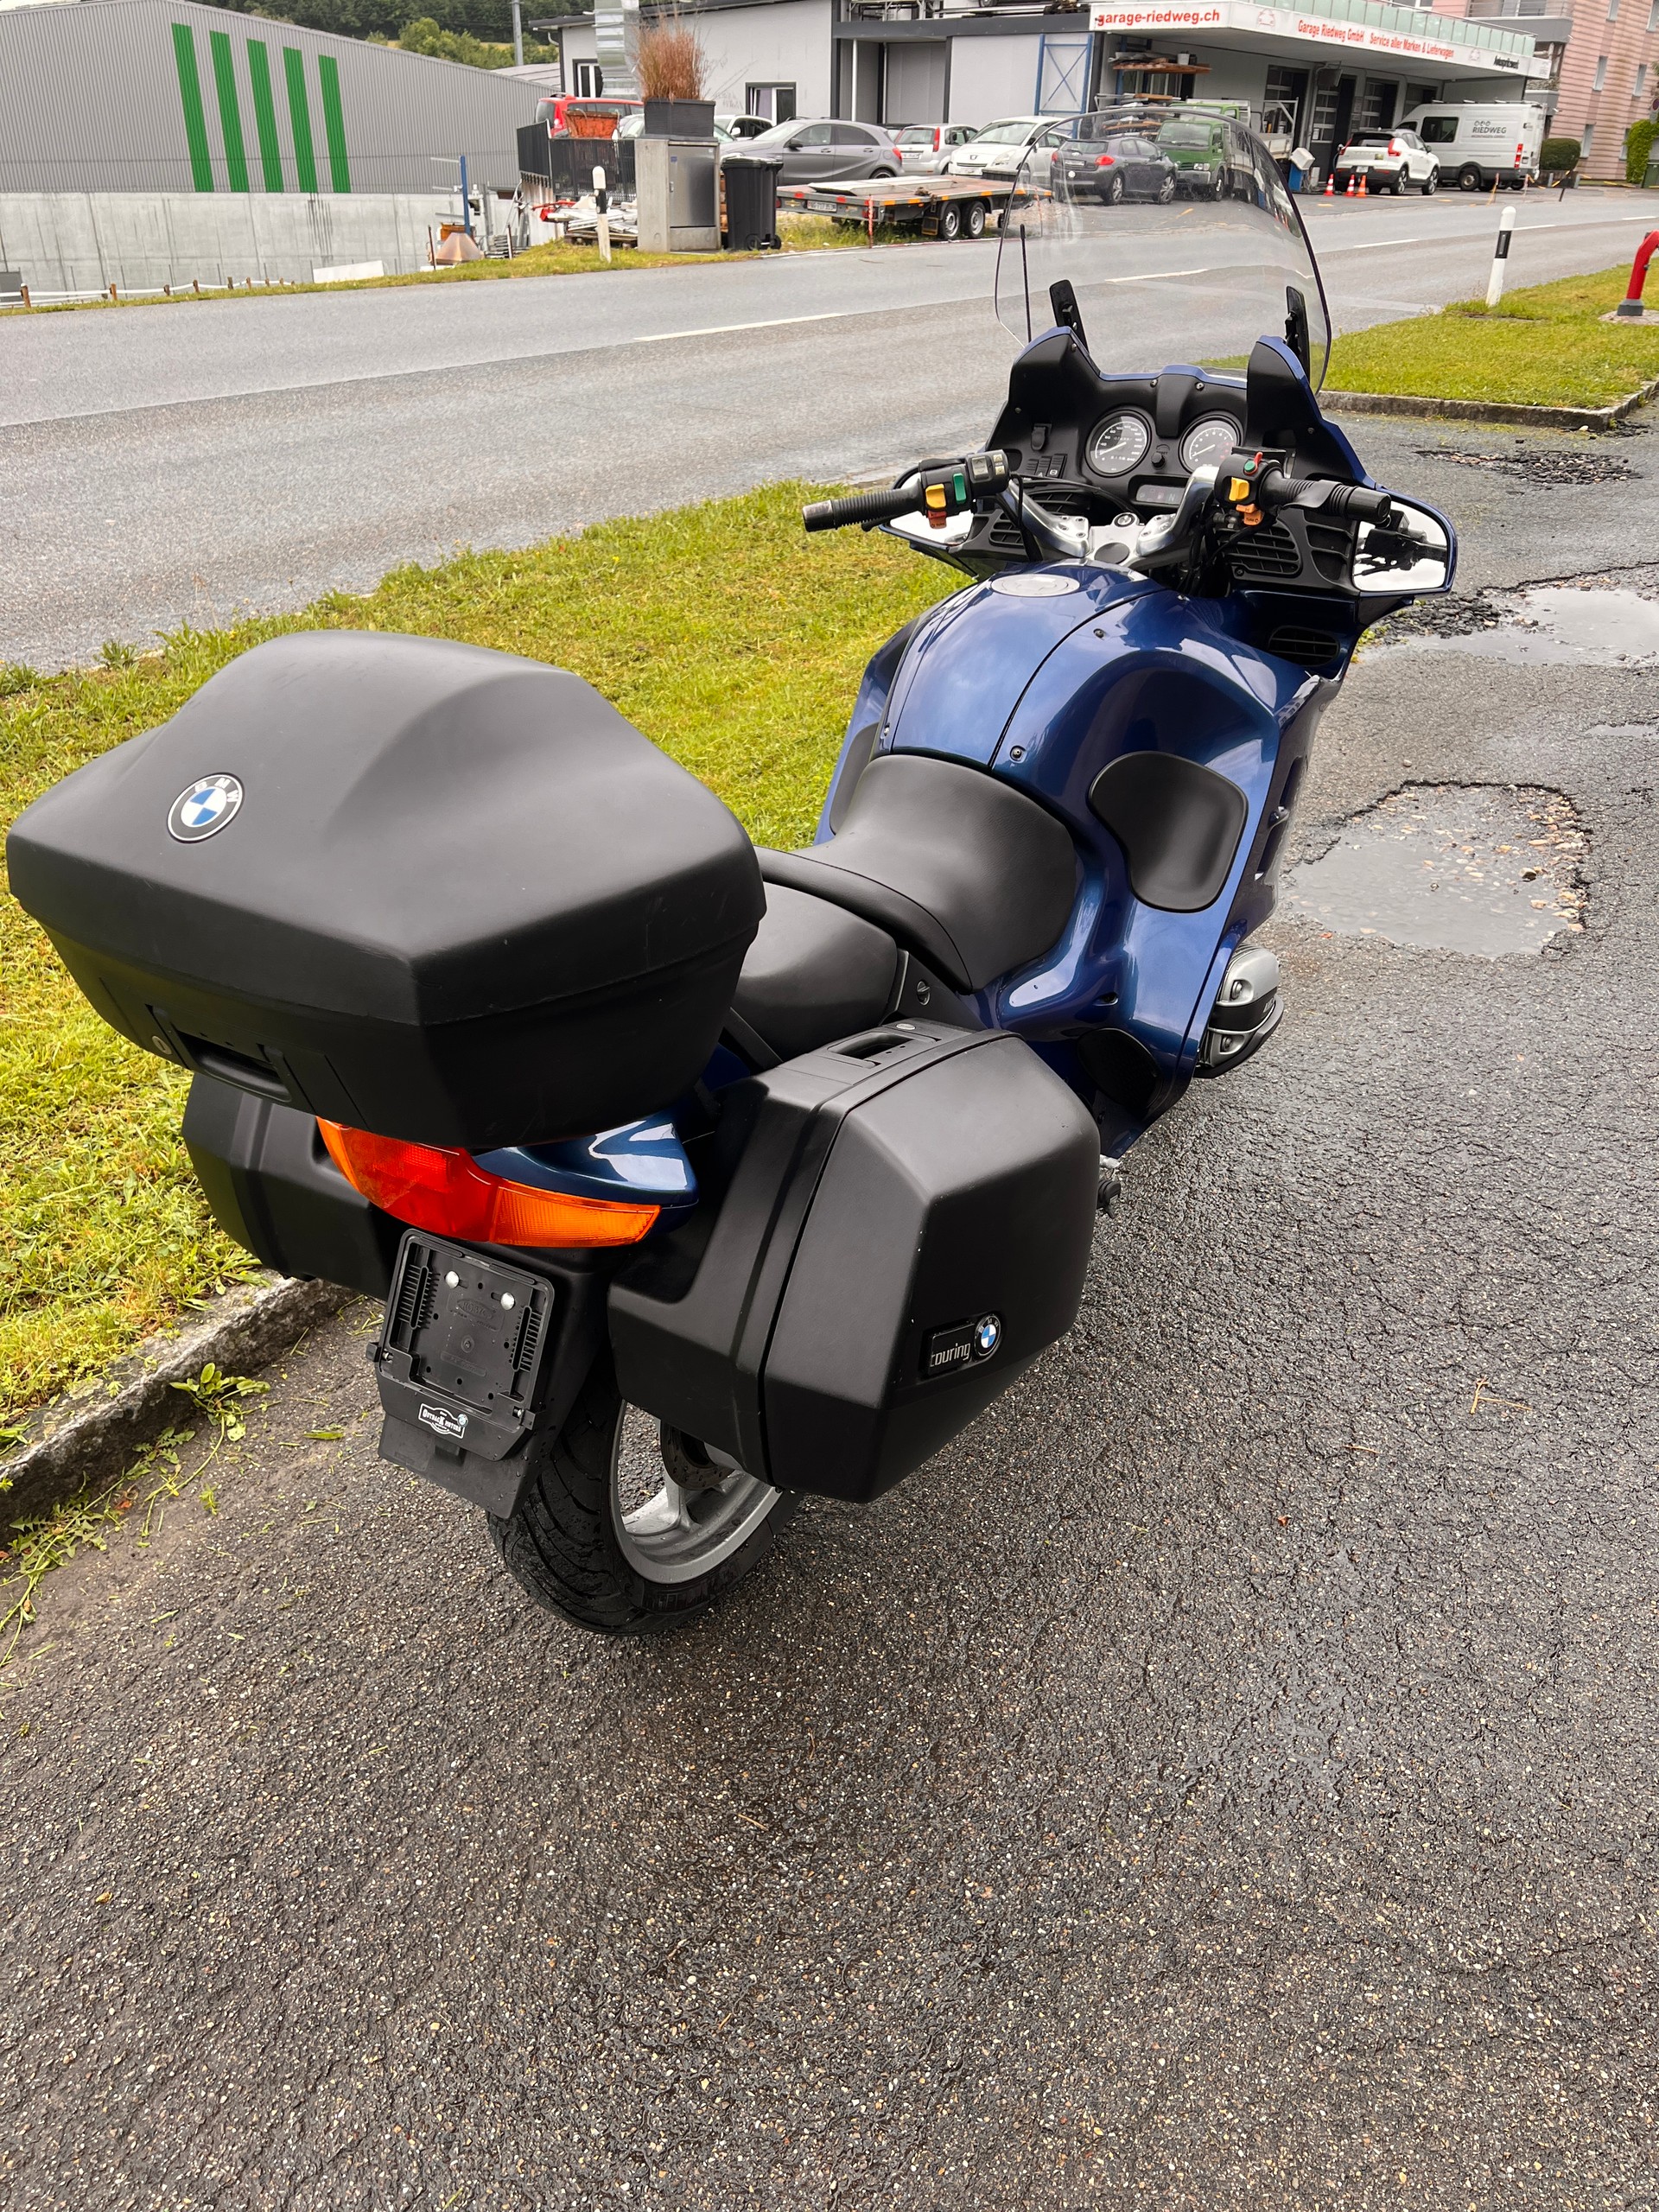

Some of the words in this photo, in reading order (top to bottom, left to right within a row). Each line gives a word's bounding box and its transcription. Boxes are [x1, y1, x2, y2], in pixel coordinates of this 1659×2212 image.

[1097, 9, 1220, 27] garage-riedweg.ch
[1298, 19, 1320, 38] Garage
[1321, 23, 1346, 42] Riedweg
[1347, 28, 1364, 42] GmbH
[1369, 33, 1389, 47] Service
